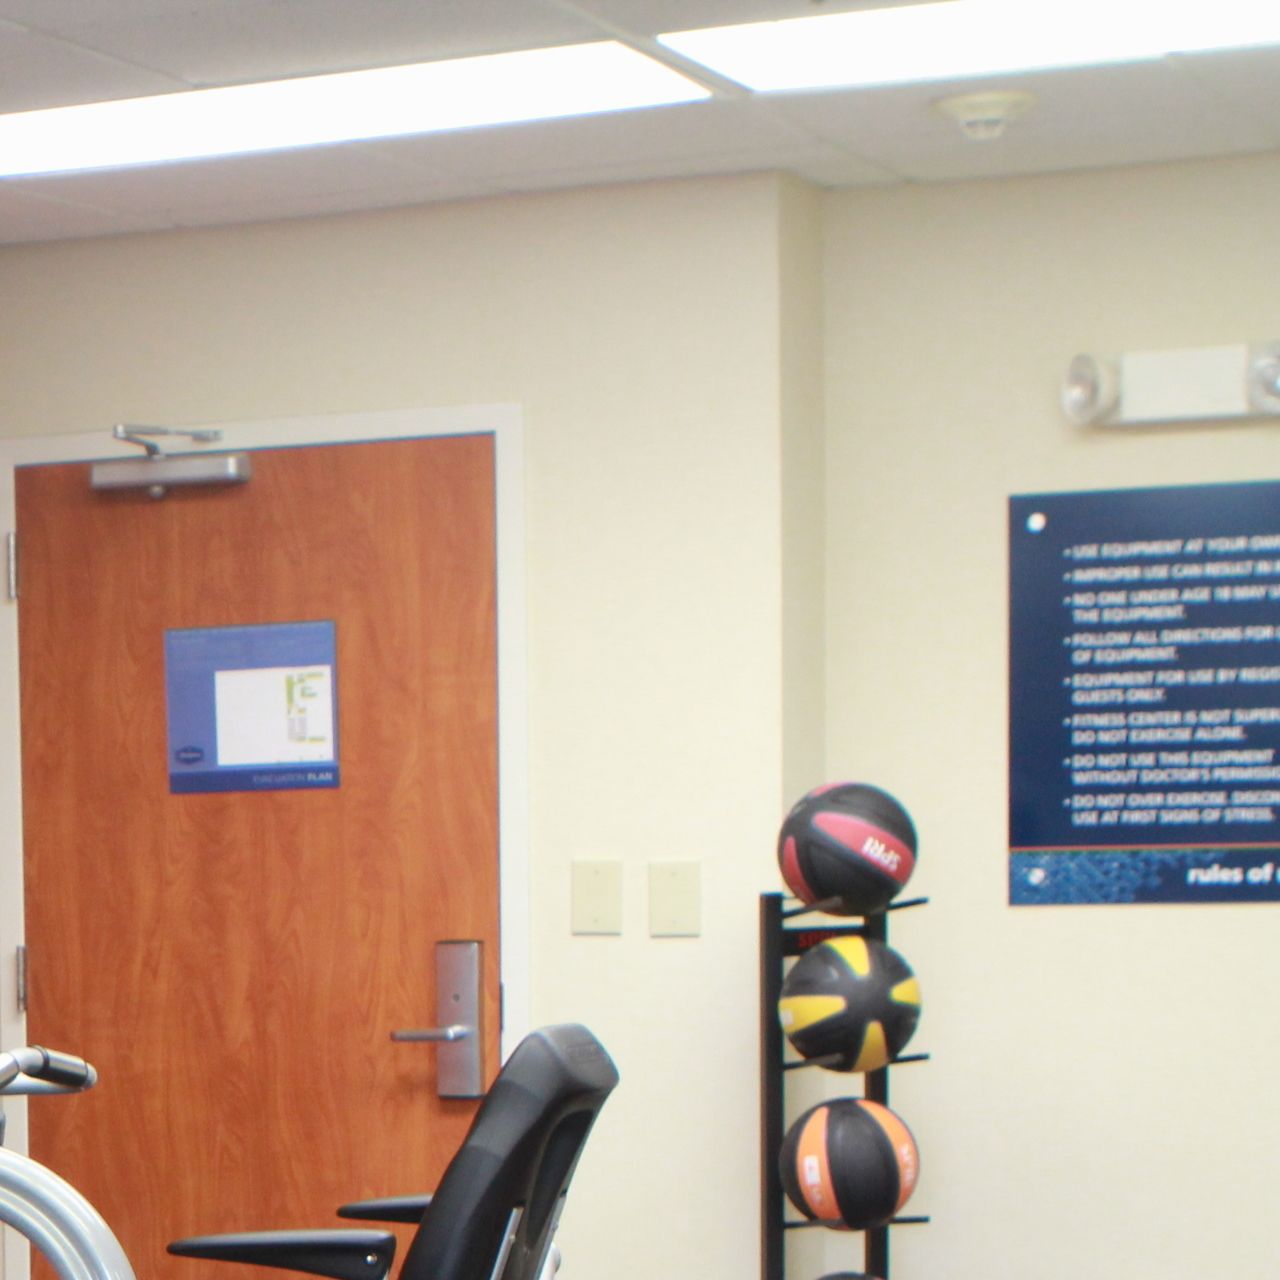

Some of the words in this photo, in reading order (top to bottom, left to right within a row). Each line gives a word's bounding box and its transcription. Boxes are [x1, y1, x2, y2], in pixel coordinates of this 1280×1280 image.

[1073, 543, 1100, 560] USE
[1101, 539, 1184, 558] EQUIPMENT
[1184, 537, 1205, 553] AT
[1206, 536, 1248, 552] YOUR
[1073, 564, 1141, 583] IMPROPER
[1142, 563, 1169, 580] USE
[1171, 562, 1204, 579] CAN
[1205, 559, 1253, 577] RESULT
[1072, 591, 1097, 607] NO
[1097, 590, 1128, 606] ONE
[1129, 588, 1180, 605] UNDER
[1181, 586, 1212, 602] AGE
[1232, 584, 1268, 600] MAY
[1073, 607, 1100, 624] THE
[1101, 604, 1188, 623] EQUIPMENT.
[1072, 631, 1132, 648] FOLLOW
[1133, 630, 1158, 645] ALL
[1160, 627, 1243, 645] DIRECTIONS
[1072, 649, 1093, 665] OF
[1094, 645, 1179, 664] EQUIPMENT.
[1072, 671, 1155, 688] EQUIPMENT
[1156, 669, 1186, 685] FOR
[1187, 668, 1215, 685] USE
[1216, 668, 1239, 683] BY
[1072, 689, 1124, 705] GUESTS
[1072, 712, 1126, 729] FITNESS
[1127, 711, 1182, 727] CENTER
[1183, 710, 1197, 726] IS
[1198, 708, 1232, 725] NOT
[1072, 729, 1096, 745] DO
[1097, 728, 1128, 745] NOT
[1129, 727, 1193, 743] EXERCISE
[1194, 726, 1248, 742] ALONE.
[1072, 754, 1096, 769] DO
[1097, 753, 1128, 768] NOT
[1129, 752, 1157, 768] USE
[1158, 751, 1190, 767] THIS
[1191, 749, 1276, 766] EQUIPMENT
[306, 772, 334, 783] PLAN
[1072, 769, 1139, 786] WITHOUT
[1140, 768, 1211, 784] DOCTOR'S
[1072, 794, 1096, 809] DO
[1096, 793, 1127, 808] NOT
[1127, 792, 1165, 808] OVER
[1072, 810, 1100, 825] USE
[1100, 810, 1121, 824] AT
[1121, 809, 1159, 824] FIRST
[1159, 808, 1200, 823] SIGNS
[1200, 808, 1222, 823] OF
[1187, 863, 1244, 884] rules
[1246, 862, 1274, 884] of
